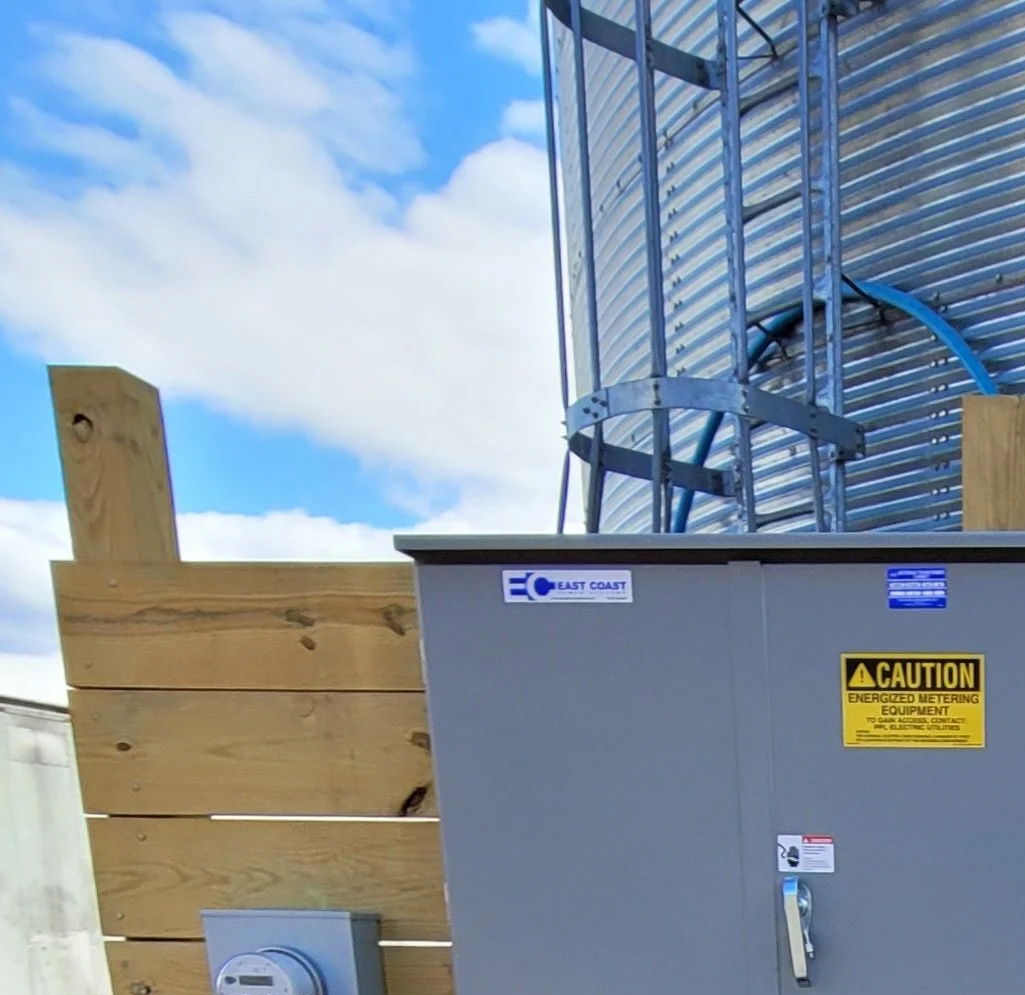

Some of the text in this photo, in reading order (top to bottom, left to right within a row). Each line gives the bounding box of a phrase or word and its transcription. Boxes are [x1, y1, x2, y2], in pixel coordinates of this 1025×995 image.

[558, 581, 626, 590] EAST COAST
[876, 661, 974, 689] CAUTION
[847, 693, 980, 705] ENERGIZED METERING
[881, 705, 950, 716] EQUIPMENT
